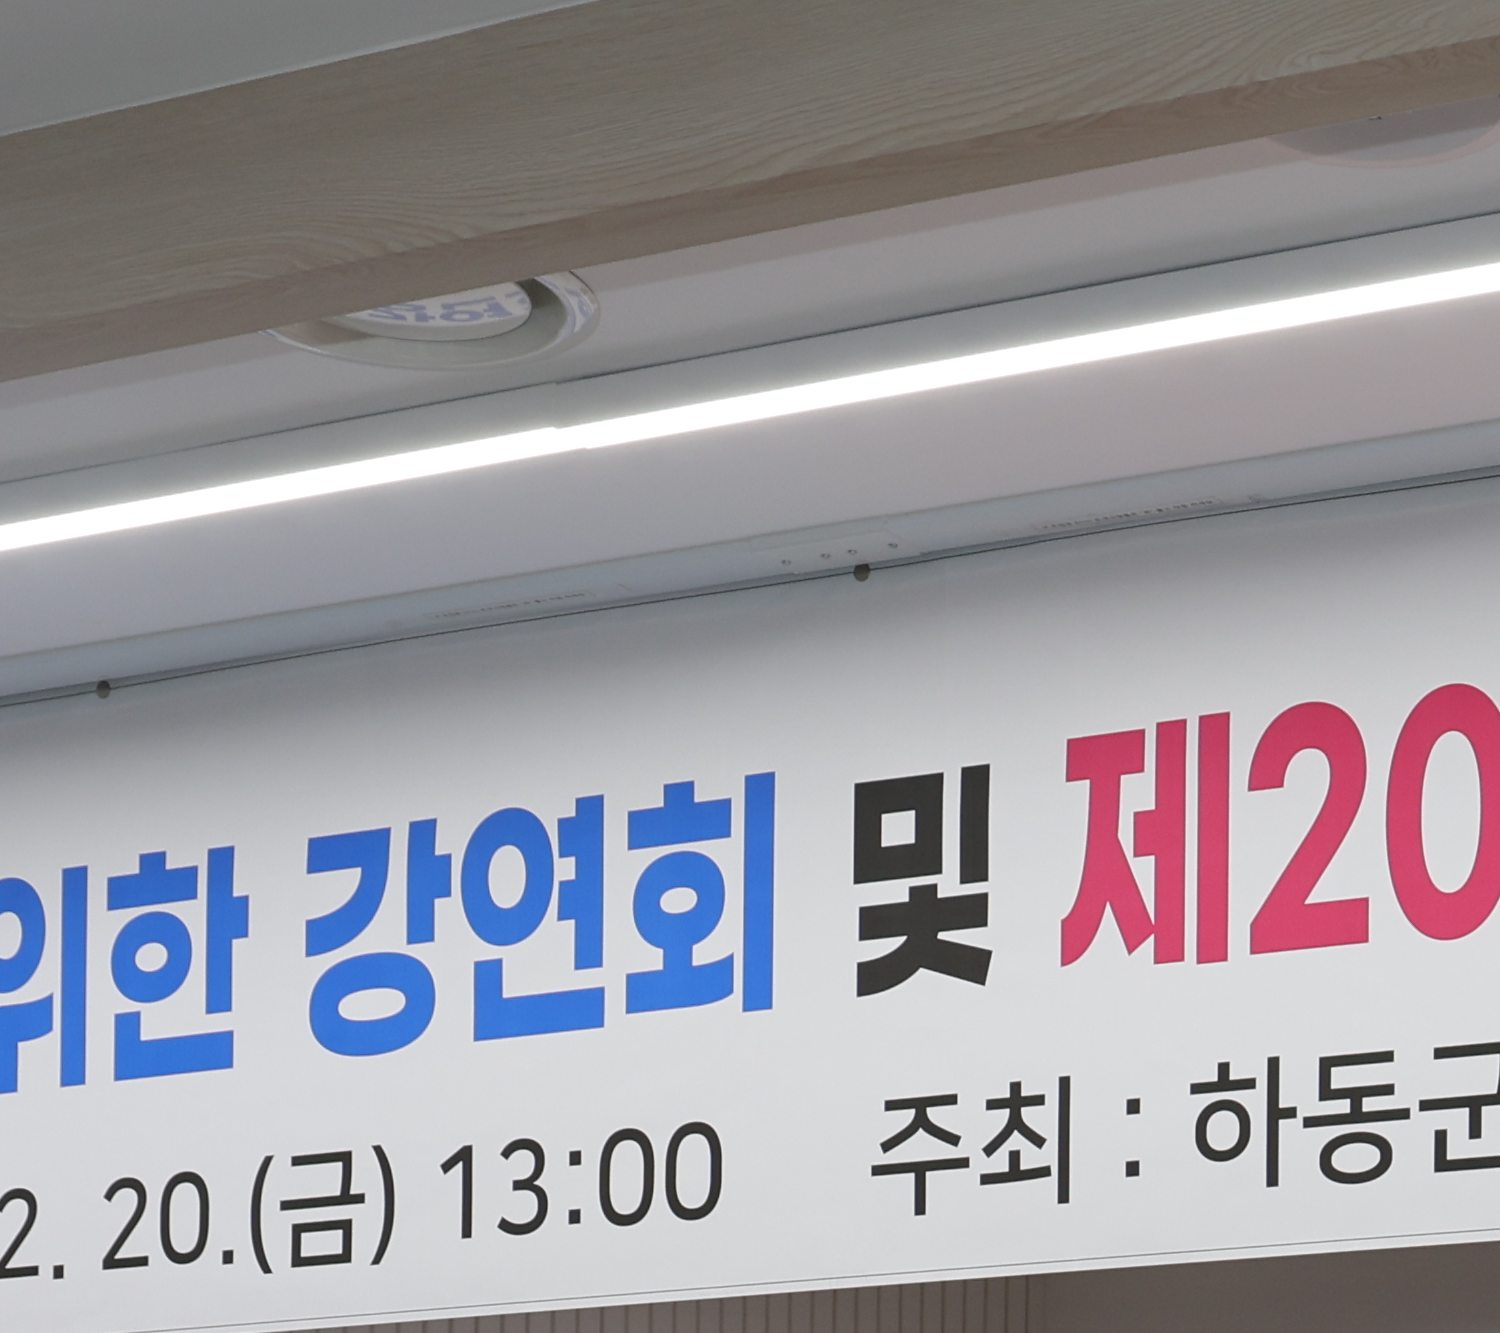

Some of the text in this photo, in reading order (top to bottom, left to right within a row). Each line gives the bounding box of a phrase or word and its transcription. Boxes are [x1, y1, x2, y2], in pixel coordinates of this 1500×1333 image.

[304, 771, 777, 1058] 강연회
[852, 763, 991, 998] 및
[441, 1122, 723, 1238] 13:00
[870, 1072, 1074, 1216] 주최
